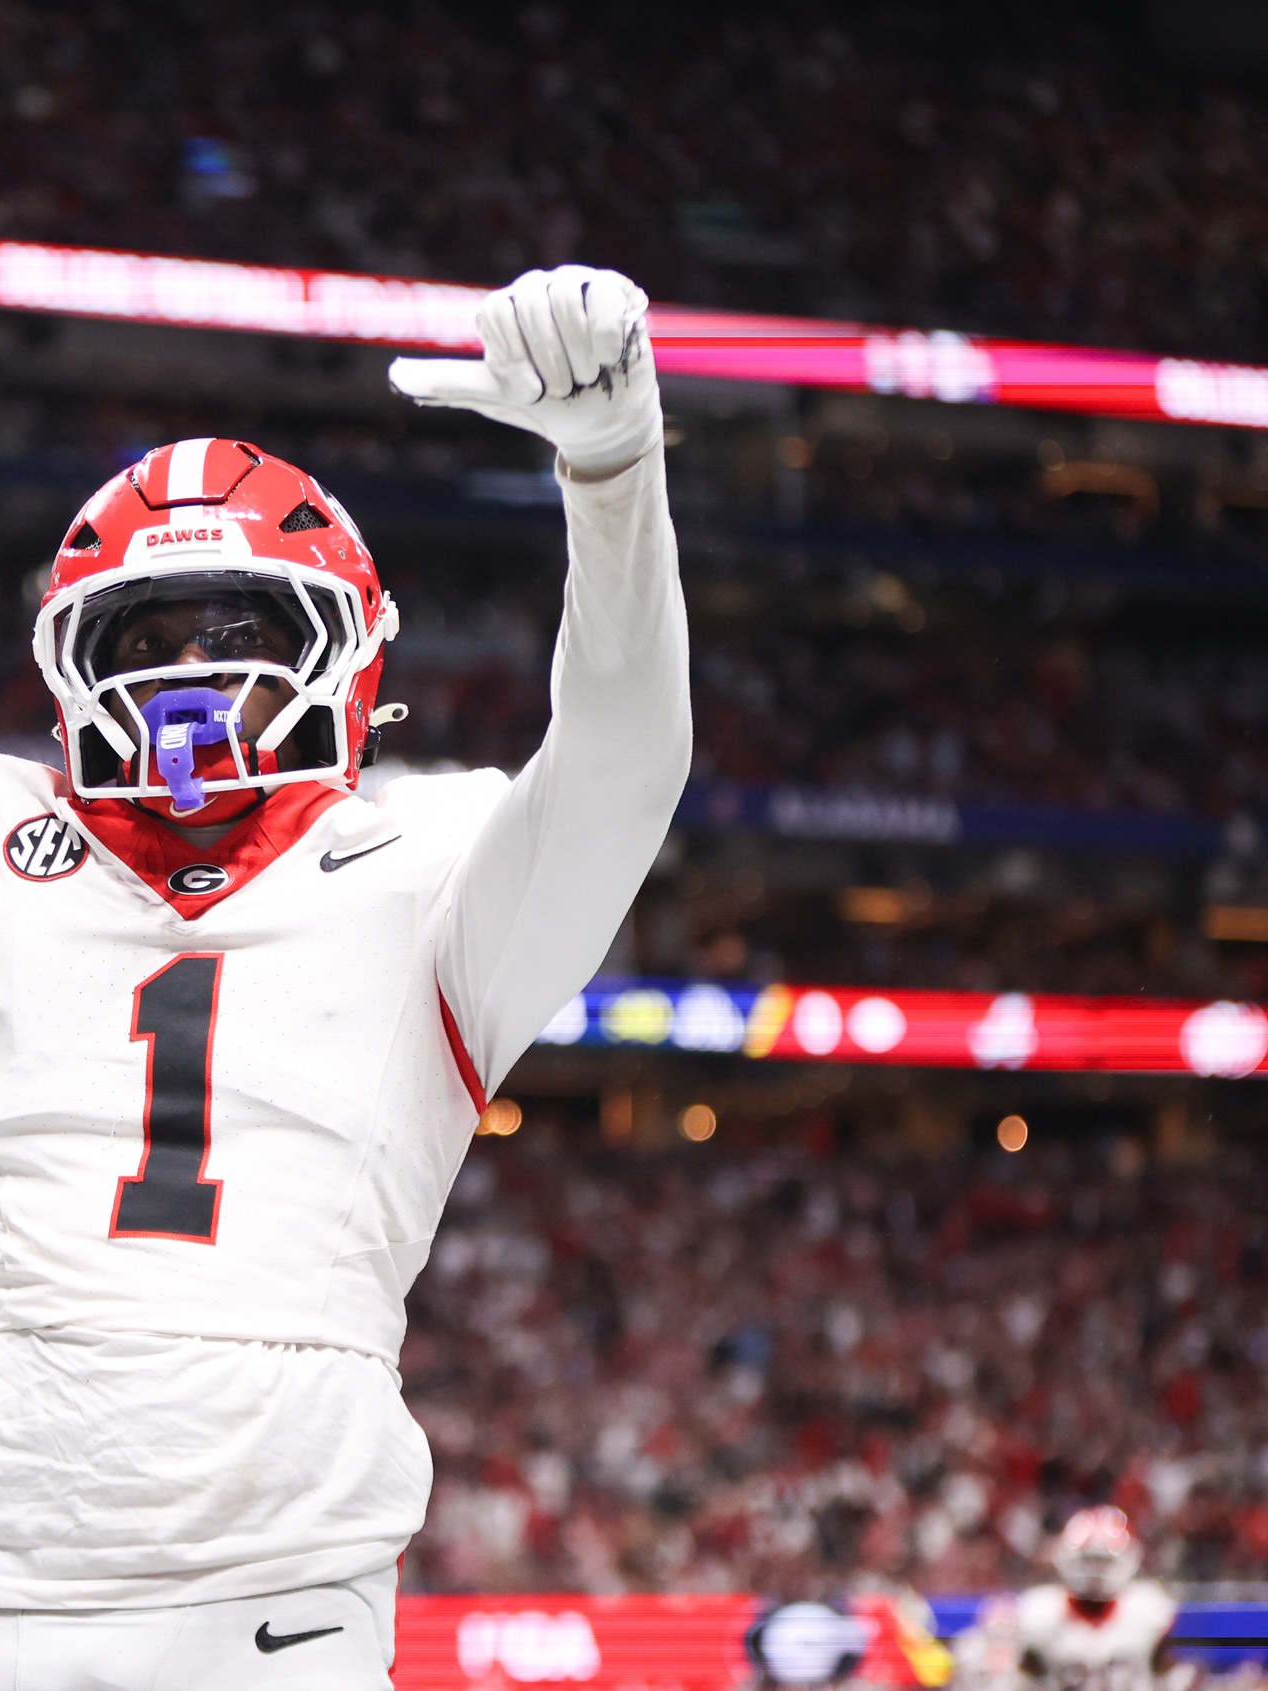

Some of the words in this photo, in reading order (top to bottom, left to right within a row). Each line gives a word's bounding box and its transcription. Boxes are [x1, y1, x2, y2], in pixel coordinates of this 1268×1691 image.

[146, 528, 224, 547] DAWGS
[10, 816, 82, 876] SEC
[181, 868, 229, 890] G
[108, 952, 225, 1245] 1
